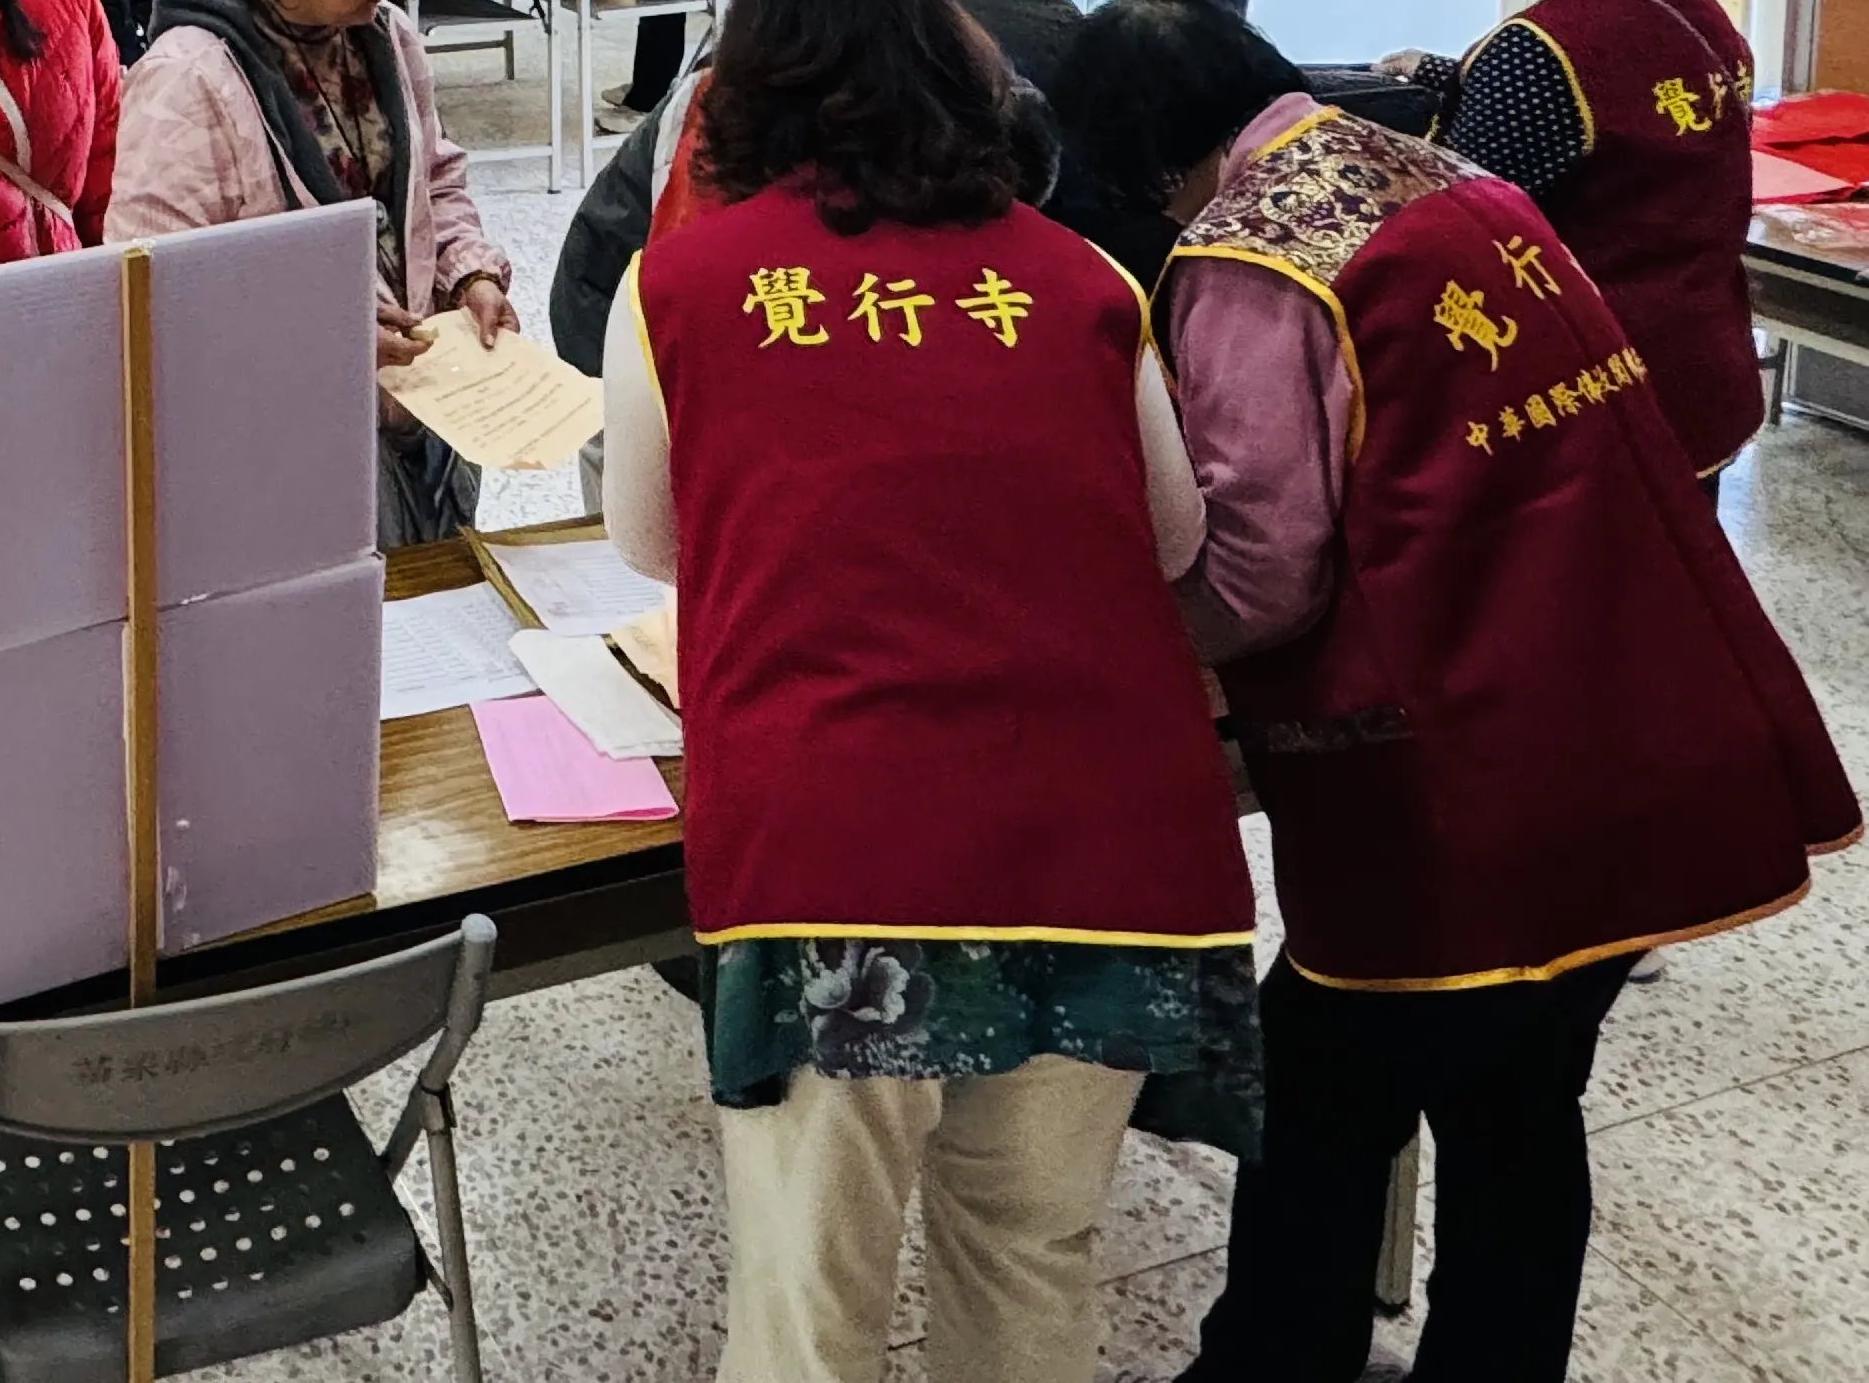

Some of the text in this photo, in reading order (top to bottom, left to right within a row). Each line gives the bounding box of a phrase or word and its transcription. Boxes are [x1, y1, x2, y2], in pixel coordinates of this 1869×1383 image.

[741, 267, 1034, 349] 覺行寺
[1433, 235, 1562, 372] 覺行
